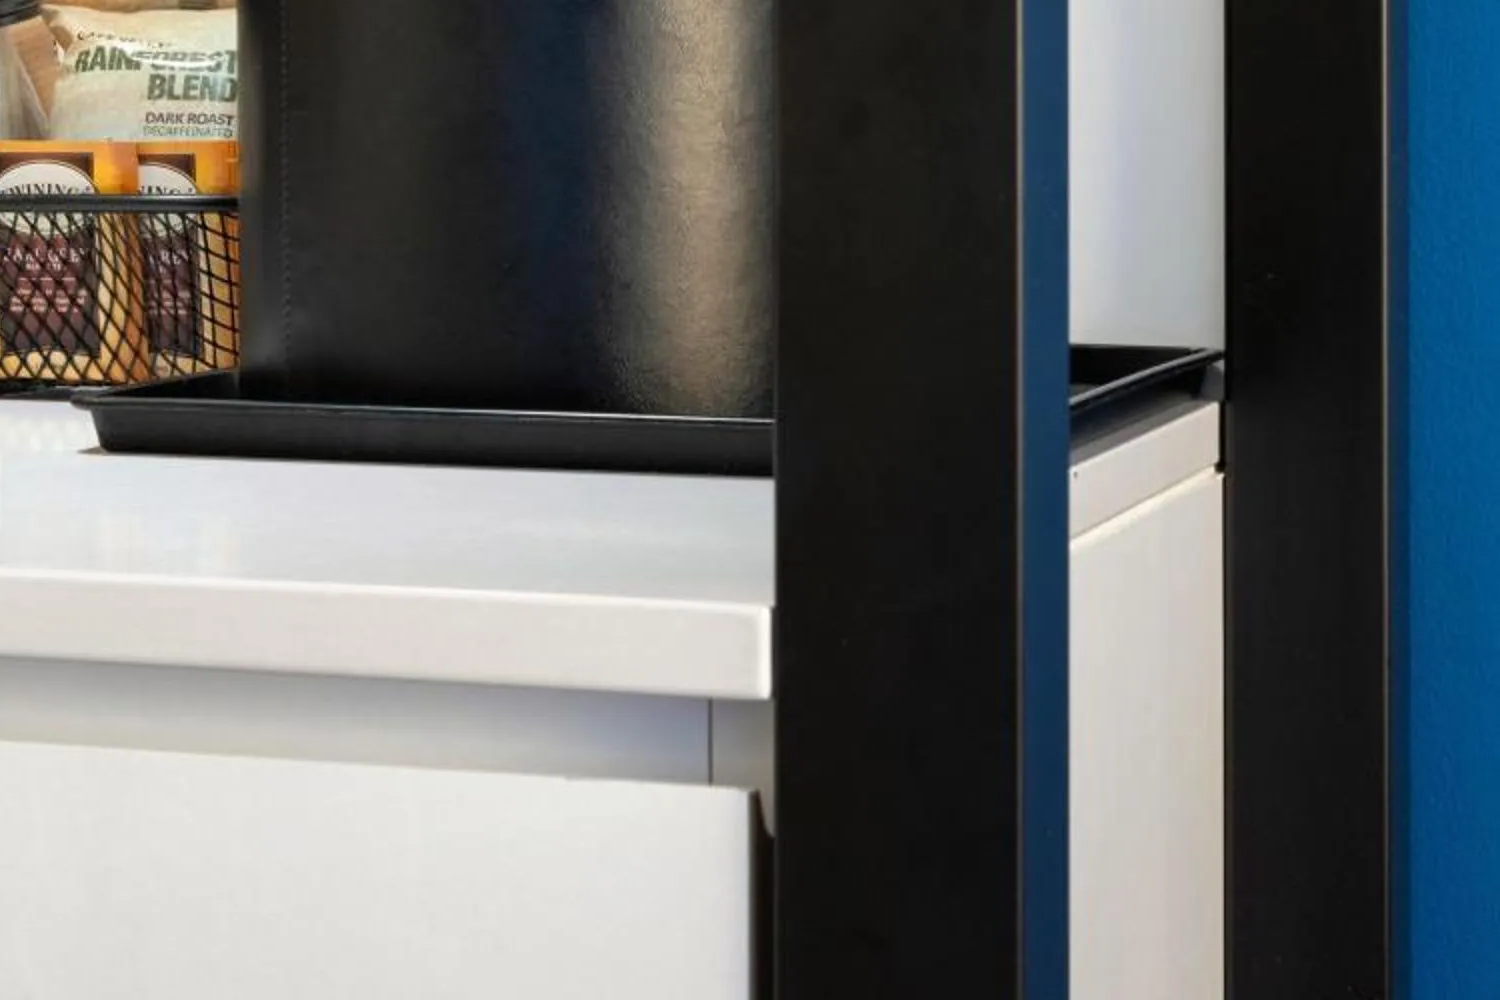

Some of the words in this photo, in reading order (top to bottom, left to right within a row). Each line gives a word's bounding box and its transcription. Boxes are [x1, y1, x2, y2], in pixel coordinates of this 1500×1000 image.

[148, 73, 238, 102] BLEND
[145, 111, 185, 125] DARK
[187, 112, 236, 126] ROAST
